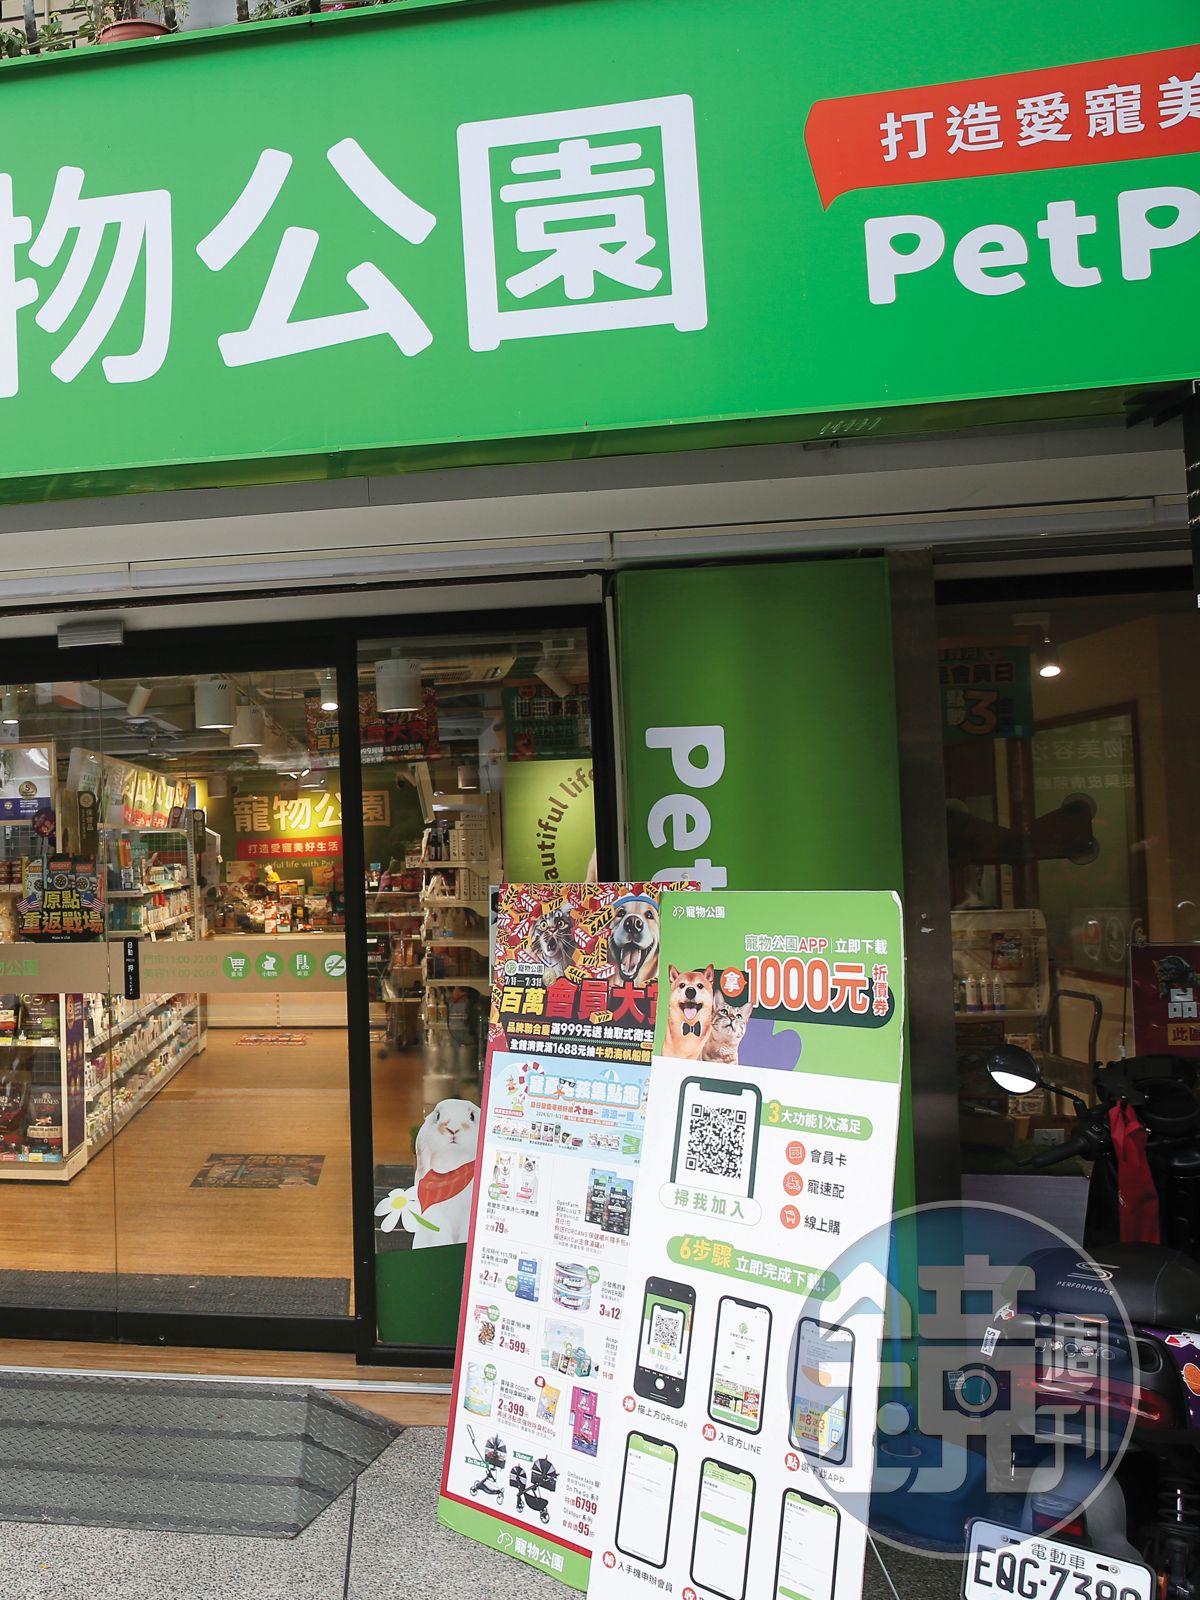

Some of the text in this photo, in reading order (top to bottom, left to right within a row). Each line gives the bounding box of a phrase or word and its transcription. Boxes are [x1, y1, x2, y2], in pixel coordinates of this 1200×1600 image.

[879, 72, 1200, 163] 打造愛寵美
[864, 186, 1200, 305] PetP
[248, 841, 339, 854] 打造愛寵美好生活
[43, 890, 80, 909] 原點
[548, 898, 564, 910] VIP
[21, 911, 104, 934] 重返戰場
[591, 910, 613, 935] SALE
[686, 905, 725, 919] 寵物公園
[574, 927, 592, 943] SALE
[745, 934, 889, 955] 寵物公園APP 立即下載
[723, 970, 741, 993] 拿
[745, 955, 870, 1015] 1000元
[872, 963, 890, 1017] 折價券
[551, 1022, 602, 1038] 滿999元送
[768, 1102, 862, 1135] 3大功能1次滿足
[810, 1149, 847, 1168] 會員卡
[807, 1179, 845, 1199] 寵速配
[674, 1189, 745, 1219] 掃我加入
[803, 1214, 842, 1236] 線上購
[679, 1236, 733, 1269] 6步驟
[1056, 1280, 1115, 1296] PERFORMANCE
[514, 1537, 564, 1572] 寵物公園
[1030, 1543, 1085, 1570] 電動車
